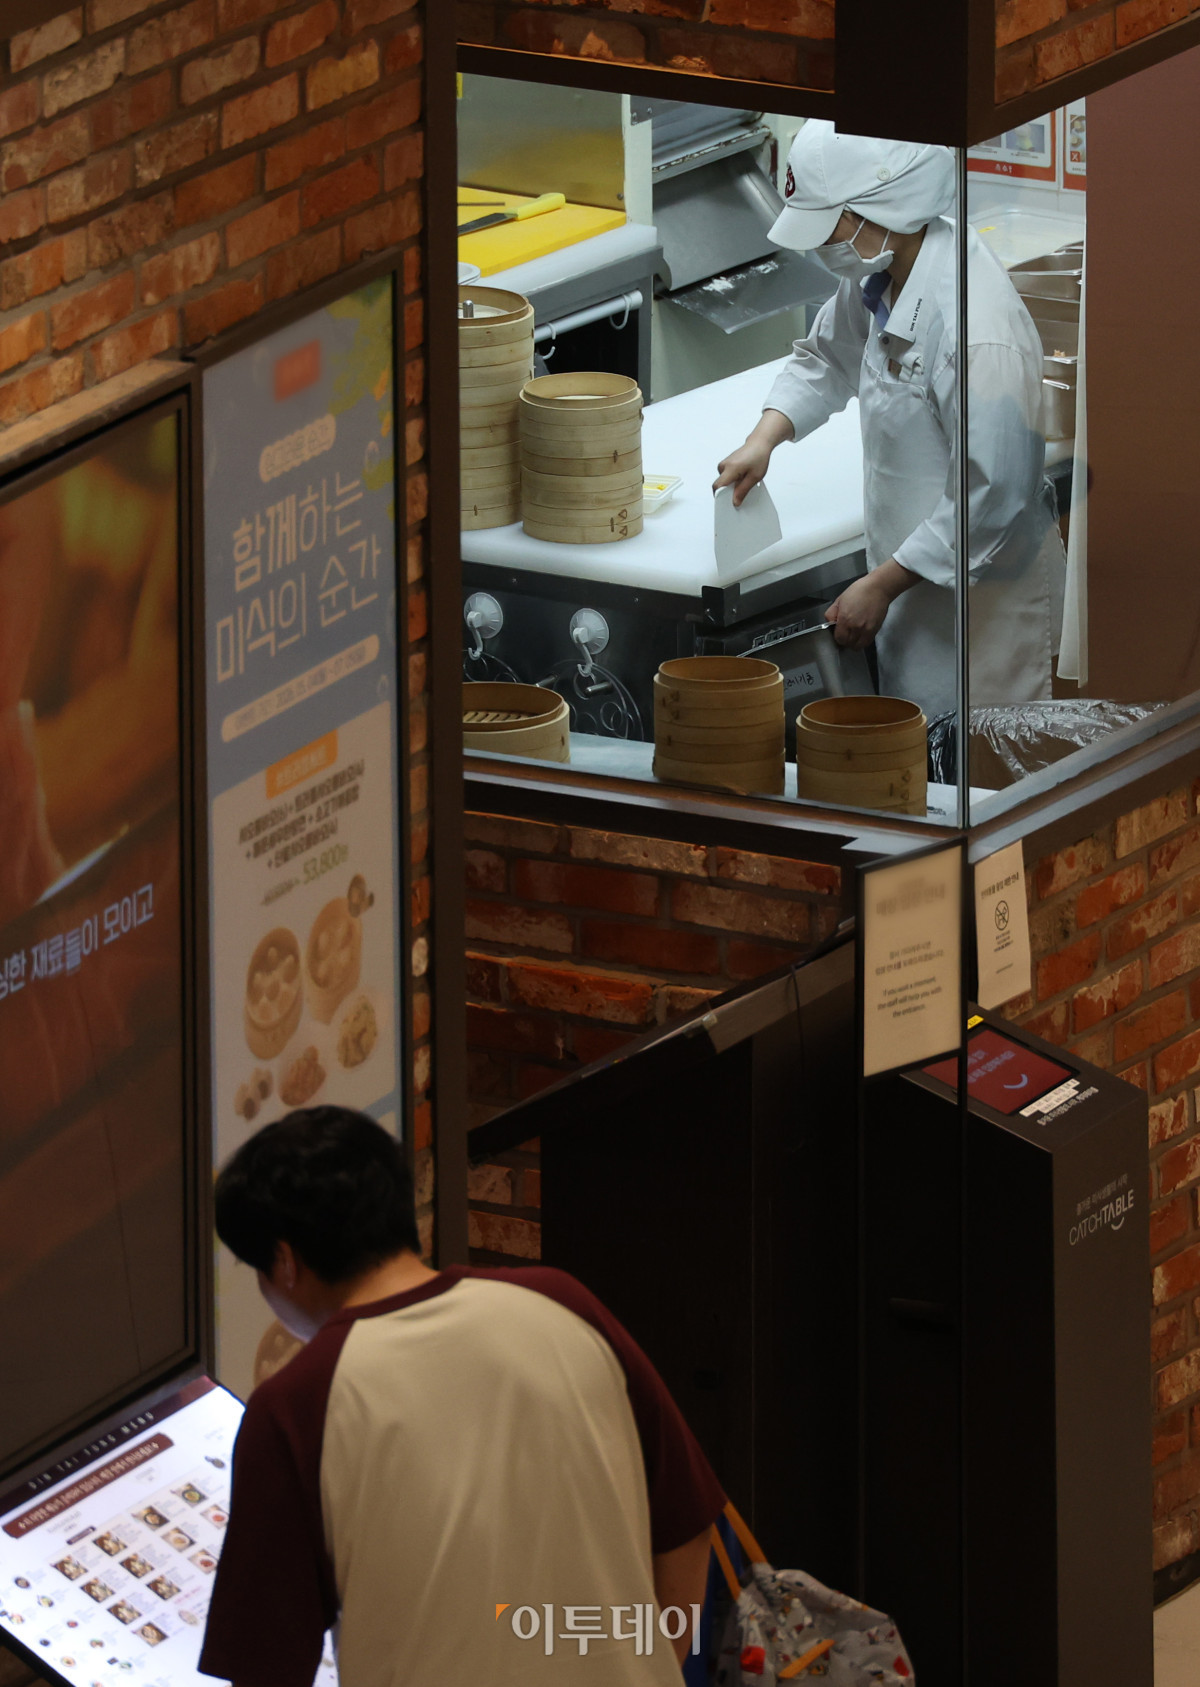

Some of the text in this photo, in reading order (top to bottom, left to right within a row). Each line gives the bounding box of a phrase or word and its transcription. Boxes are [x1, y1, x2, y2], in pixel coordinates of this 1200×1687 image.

[233, 472, 363, 592] 함께하는
[216, 533, 382, 683] 미식의 순간
[31, 913, 99, 982] 재료들이
[103, 882, 154, 945] 모이고
[1069, 1188, 1134, 1246] CATCHTABLE
